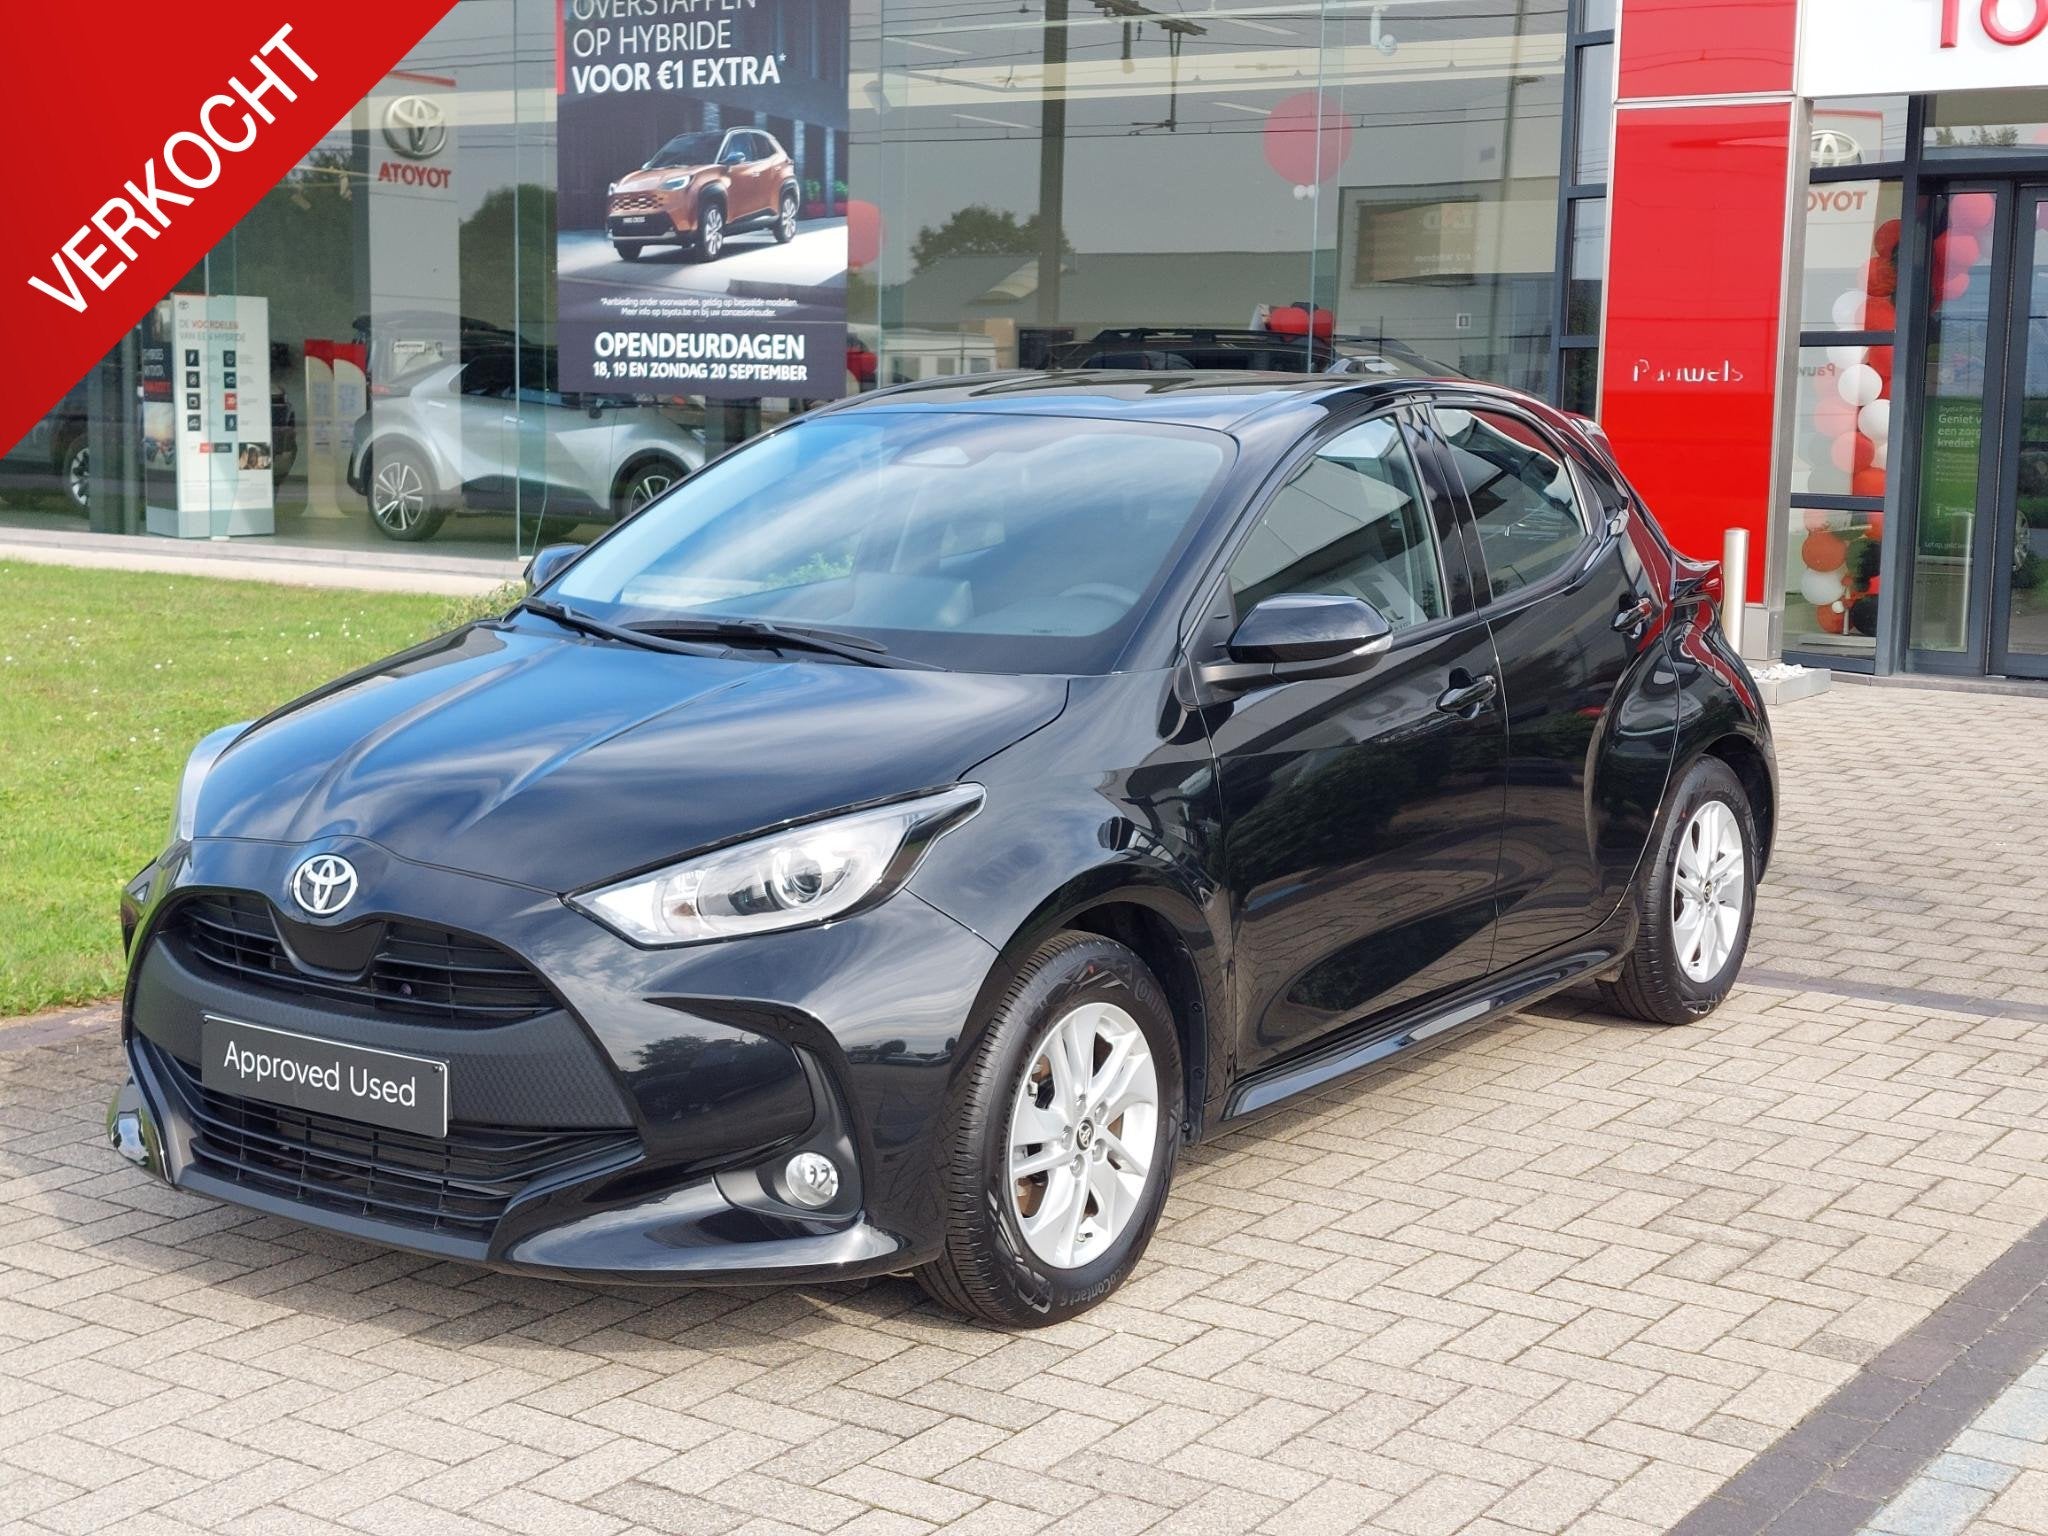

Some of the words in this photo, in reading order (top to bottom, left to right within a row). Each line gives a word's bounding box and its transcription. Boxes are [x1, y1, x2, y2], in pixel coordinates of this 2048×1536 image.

[573, 0, 756, 20] OVERST
[573, 27, 610, 57] OP
[619, 19, 732, 54] HYBRIDE
[572, 62, 651, 94] VOOR
[656, 60, 684, 90] €1
[594, 331, 805, 360] OPENDEURDAGEN
[592, 361, 611, 378] 18,
[612, 362, 627, 376] 19
[629, 362, 648, 377] EN
[649, 362, 708, 378] ZONDAG
[709, 363, 727, 379] 20
[729, 364, 808, 381] SEPTEMBER
[1938, 414, 1974, 424] Geniet
[1937, 438, 1975, 448] krediet
[223, 1040, 341, 1092] Approved
[349, 1065, 416, 1108] Used
